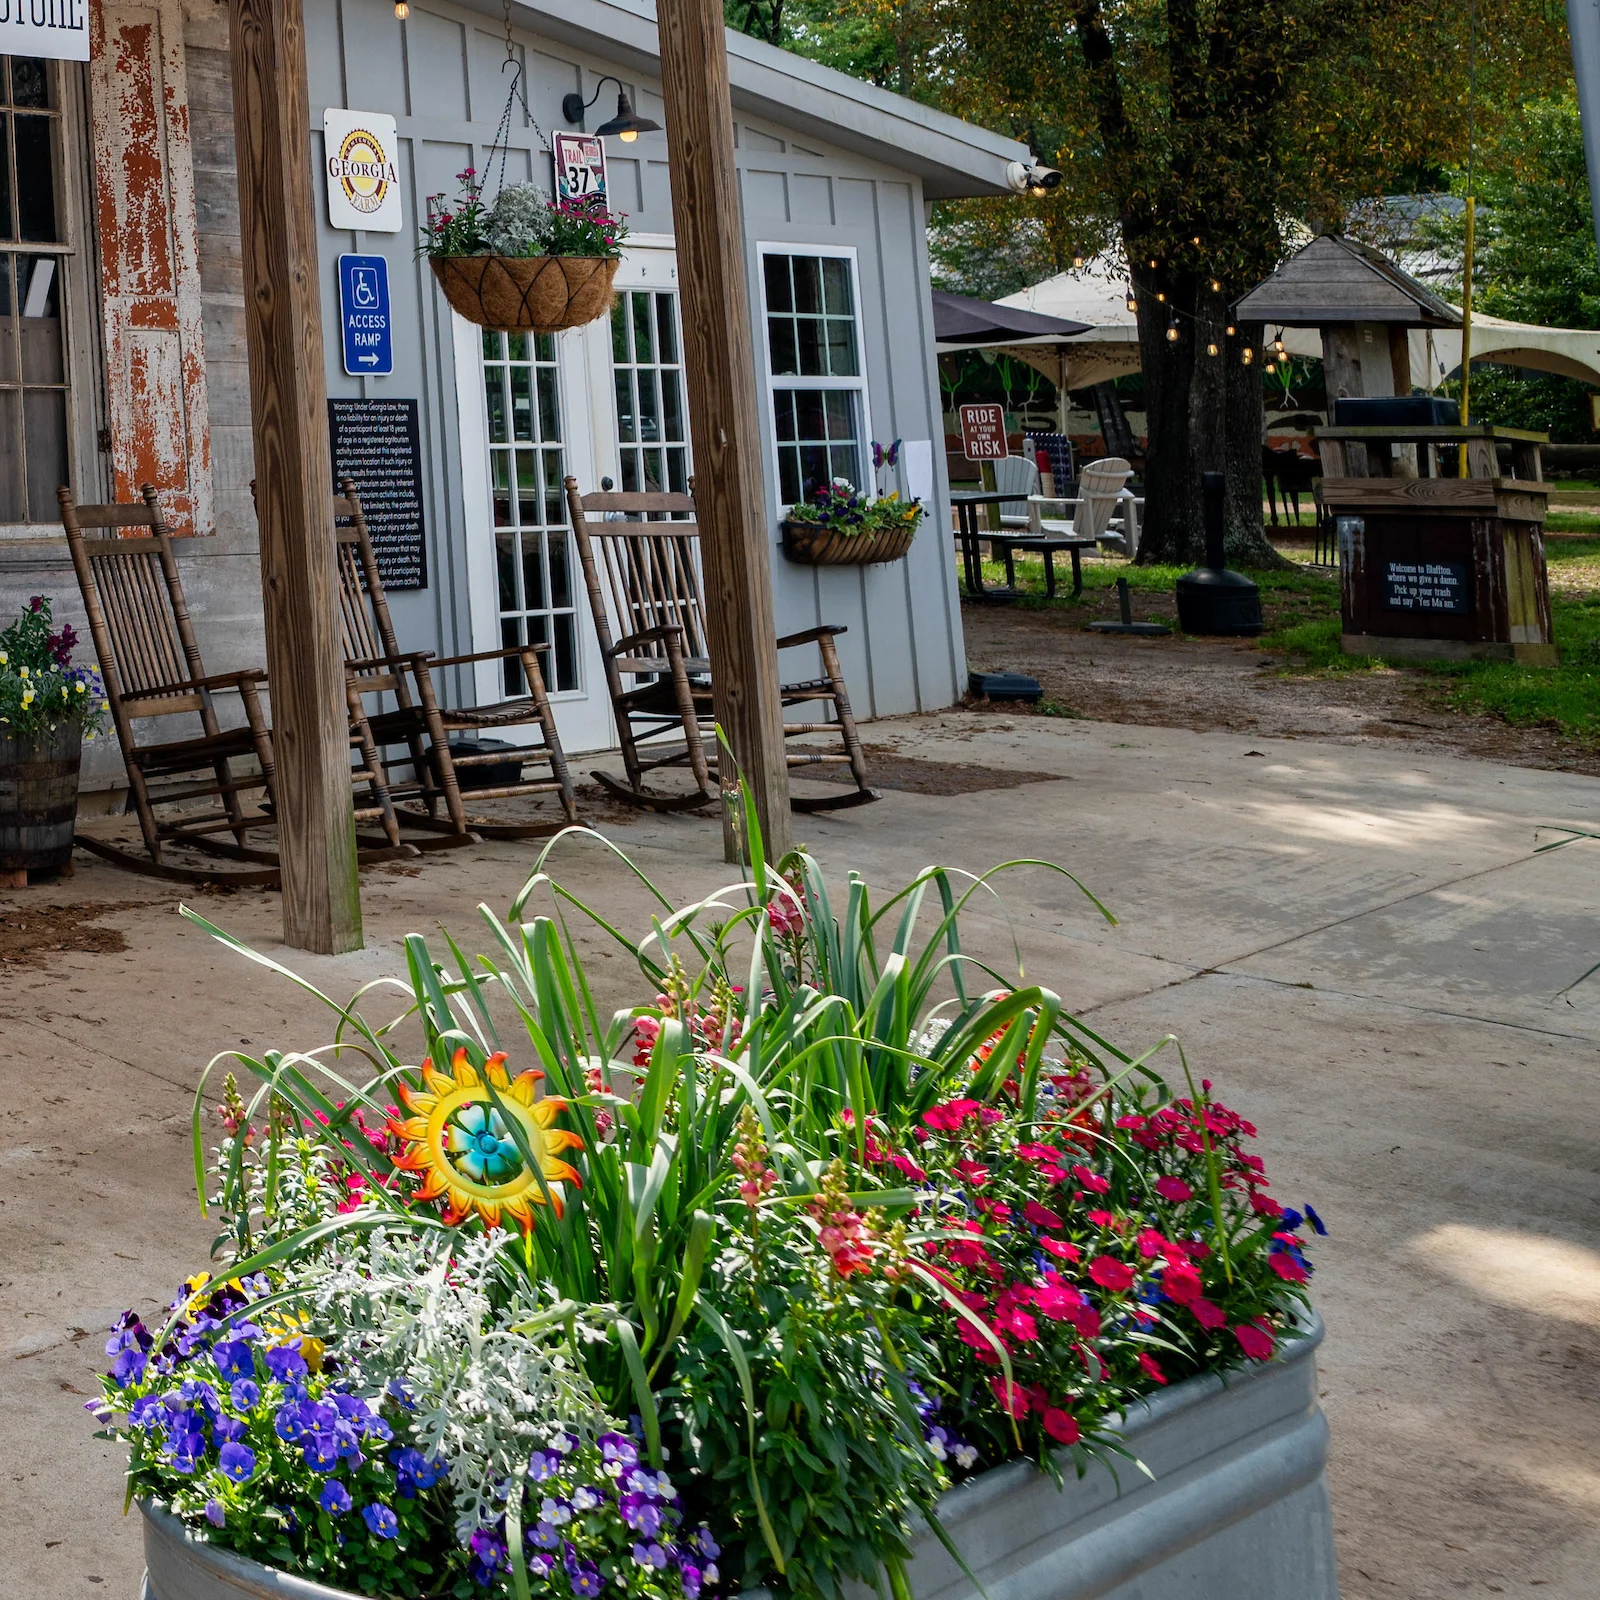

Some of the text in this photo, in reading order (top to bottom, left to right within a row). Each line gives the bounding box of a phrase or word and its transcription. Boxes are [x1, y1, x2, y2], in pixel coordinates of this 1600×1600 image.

[564, 149, 583, 164] TRAIL
[329, 157, 397, 183] GEORGIA
[569, 167, 588, 193] 37
[353, 195, 379, 210] FARM
[349, 314, 386, 328] ACCESS
[354, 333, 381, 346] RAMP
[334, 403, 354, 412] Warning:
[369, 403, 386, 412] Georgia
[388, 403, 397, 412] Law,
[967, 409, 996, 423] RIDE
[971, 441, 1000, 455] RISK
[1390, 563, 1416, 573] Welcome
[1418, 565, 1424, 573] to
[1388, 574, 1406, 582] where
[1419, 576, 1432, 585] give
[1394, 585, 1451, 597] Pick up your trash
[1390, 597, 1400, 605] and
[1403, 599, 1413, 608] say
